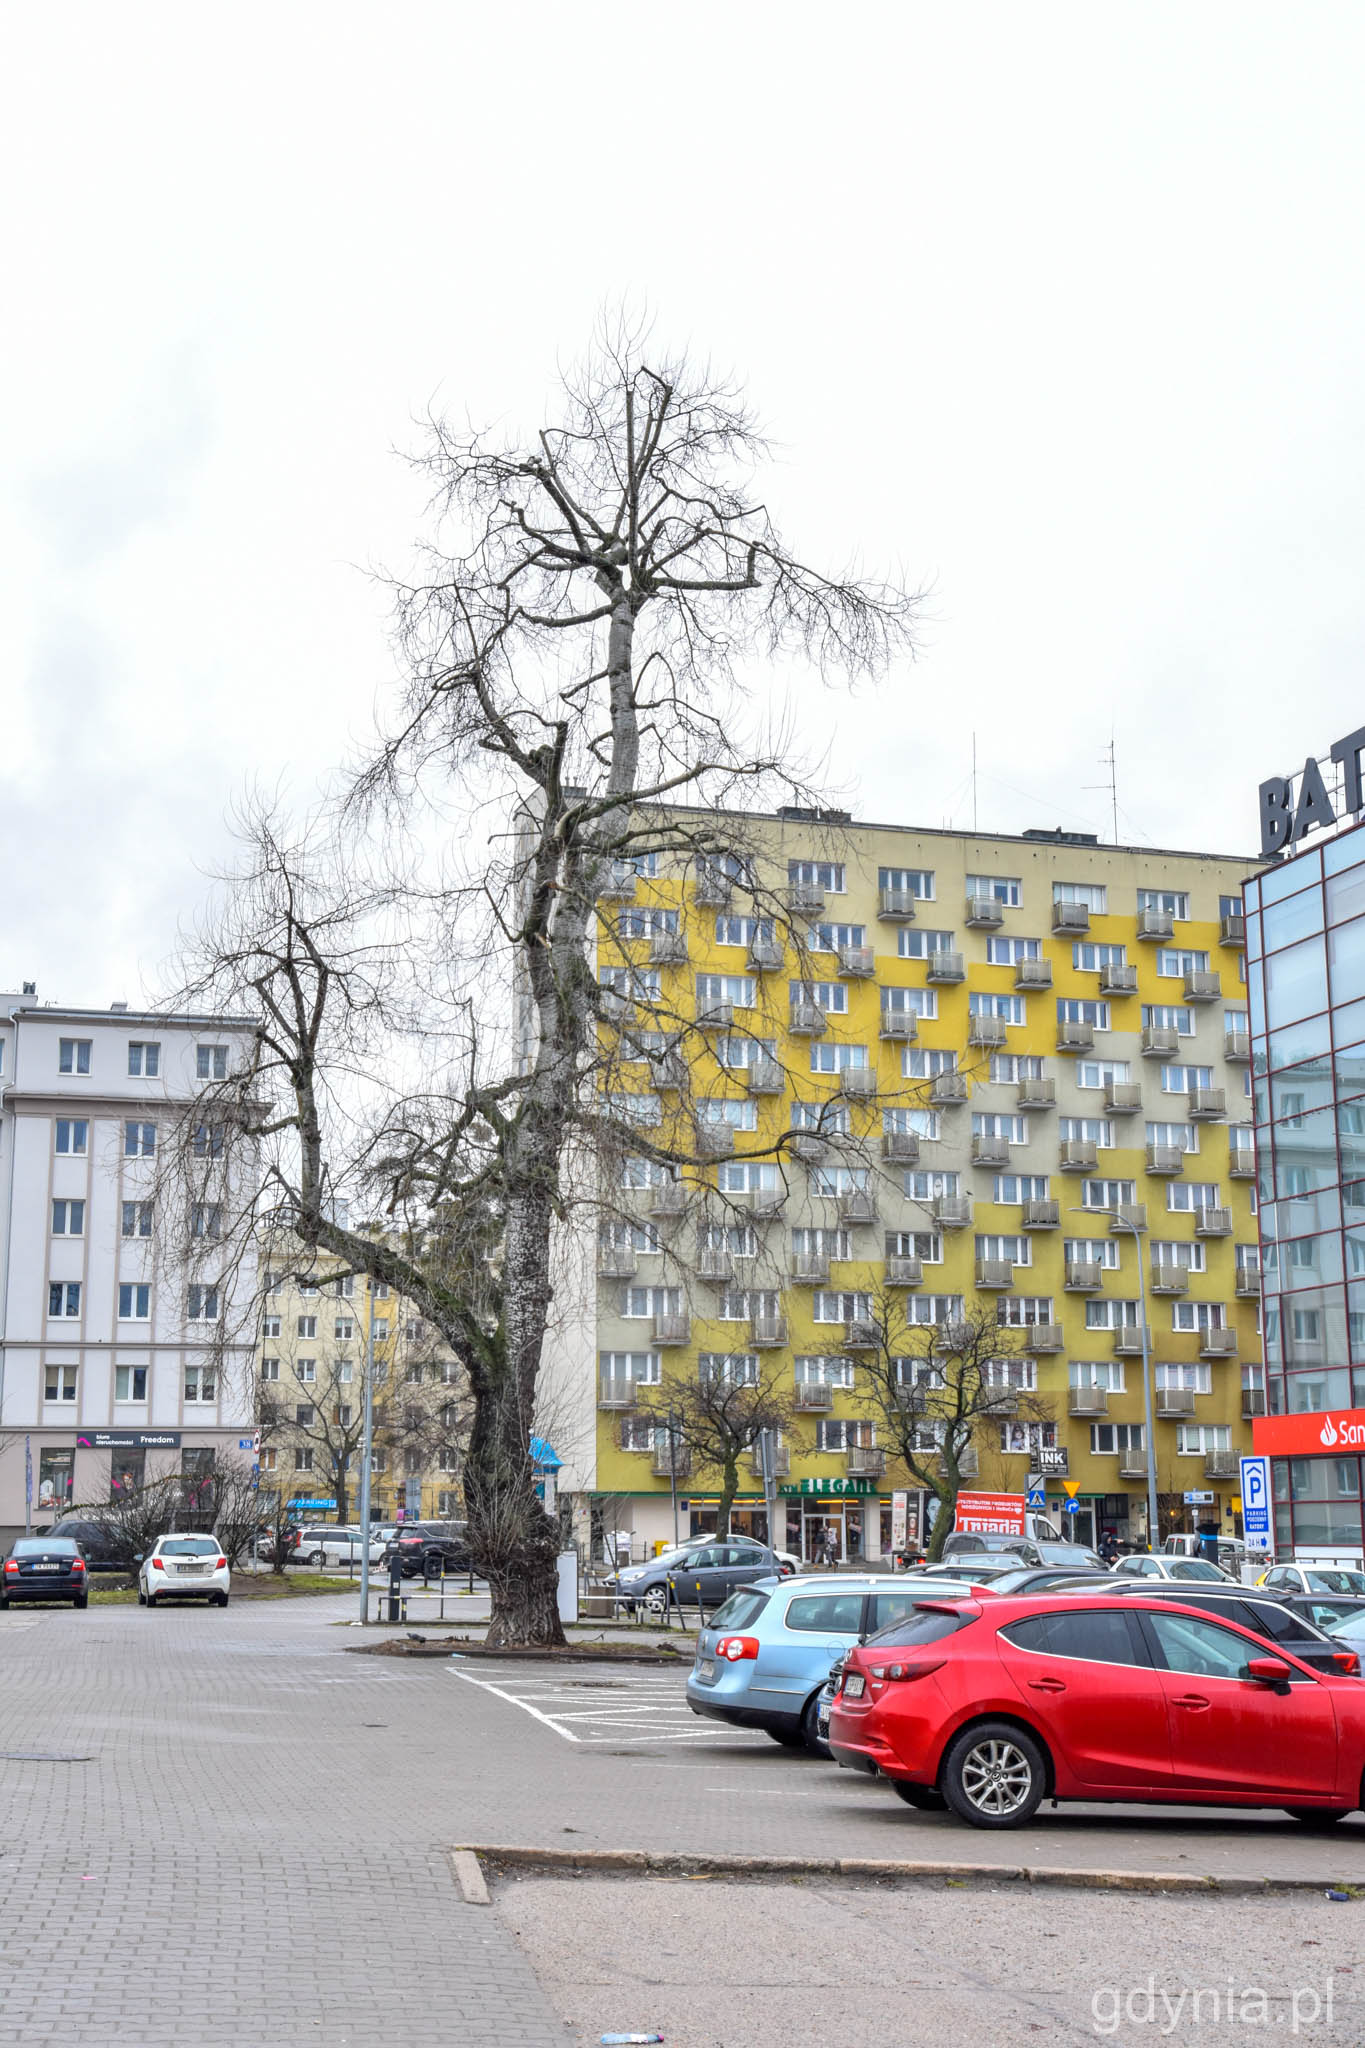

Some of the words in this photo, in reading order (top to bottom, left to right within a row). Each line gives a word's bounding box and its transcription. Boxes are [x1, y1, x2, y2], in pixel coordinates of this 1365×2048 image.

[140, 1436, 174, 1444] Freedom
[1040, 1453, 1064, 1463] INK
[1250, 1477, 1261, 1503] P
